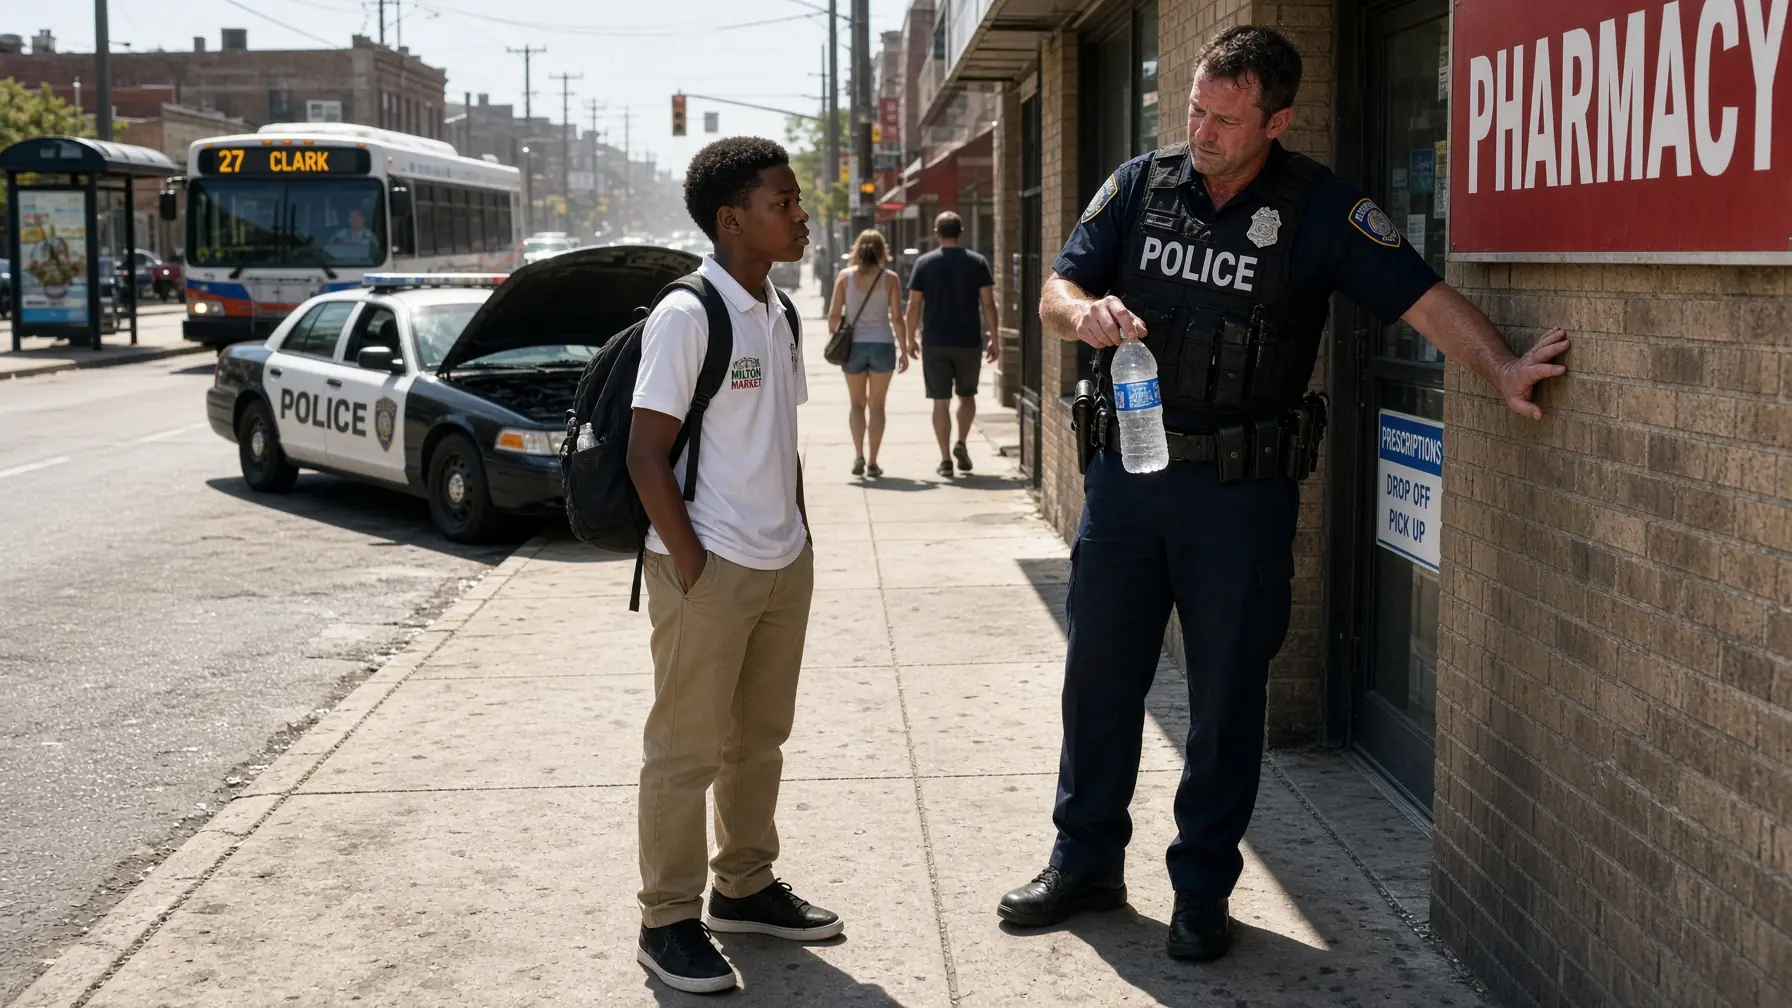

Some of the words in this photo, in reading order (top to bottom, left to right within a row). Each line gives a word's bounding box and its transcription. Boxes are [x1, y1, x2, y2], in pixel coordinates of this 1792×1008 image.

[1468, 0, 1789, 194] PHARMACY
[218, 149, 244, 173] 27
[269, 151, 329, 172] CLARK
[1139, 236, 1258, 292] POLICE
[731, 368, 761, 380] MILTON
[731, 378, 761, 390] MARKET
[280, 388, 367, 438] POLICE
[1381, 426, 1442, 465] PRESCRIPTIONS
[1387, 473, 1410, 501] DROP
[1413, 481, 1430, 509] OFF
[1389, 508, 1409, 538] PICK
[1412, 517, 1425, 543] UP
